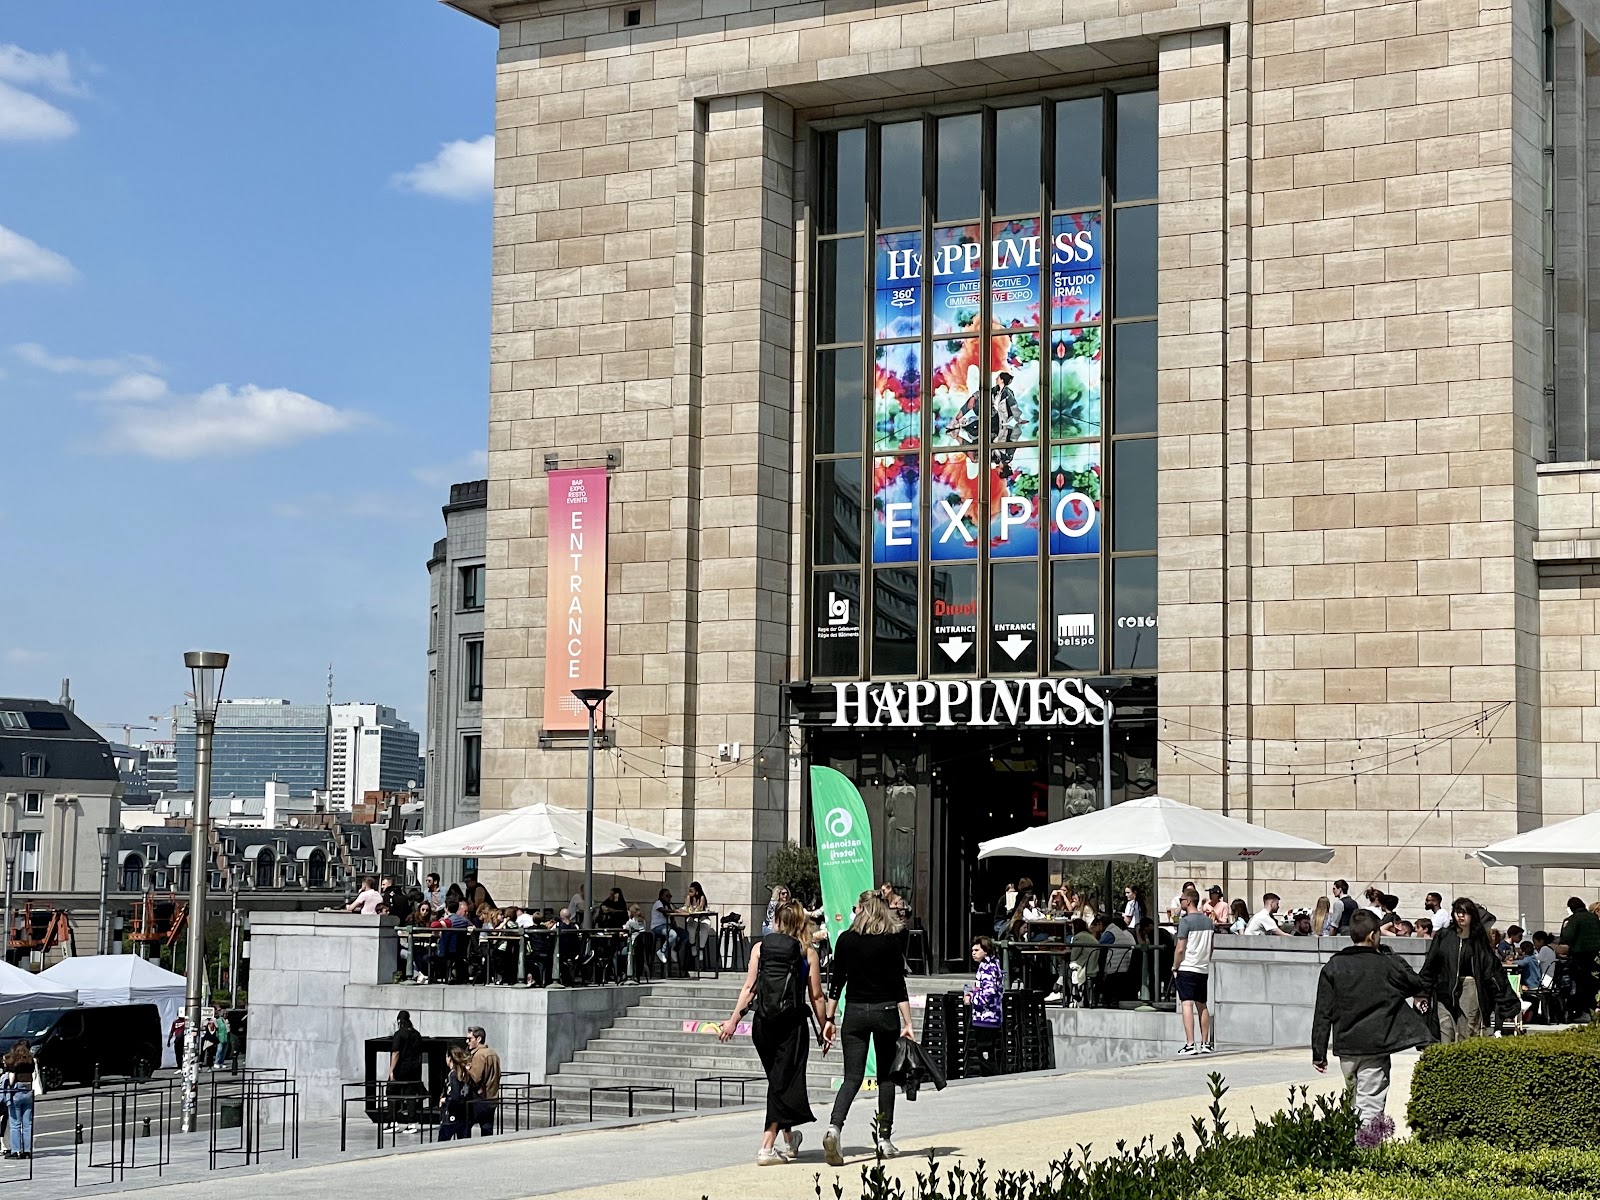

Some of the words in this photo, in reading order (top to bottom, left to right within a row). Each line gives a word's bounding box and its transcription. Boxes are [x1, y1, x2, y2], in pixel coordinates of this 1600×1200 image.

[887, 231, 1094, 280] HAPPINESS
[1054, 274, 1095, 287] STUDIO
[1007, 290, 1030, 301] EXPO
[1054, 286, 1083, 297] IRMA
[885, 492, 1096, 546] EXPO
[567, 512, 583, 678] ENTRANCE
[935, 625, 976, 634] ENTRANCE
[994, 623, 1036, 632] ENTRANCE
[1057, 636, 1095, 647] belspo
[831, 678, 1114, 726] HAPPINESS
[1054, 843, 1082, 852] Duvel
